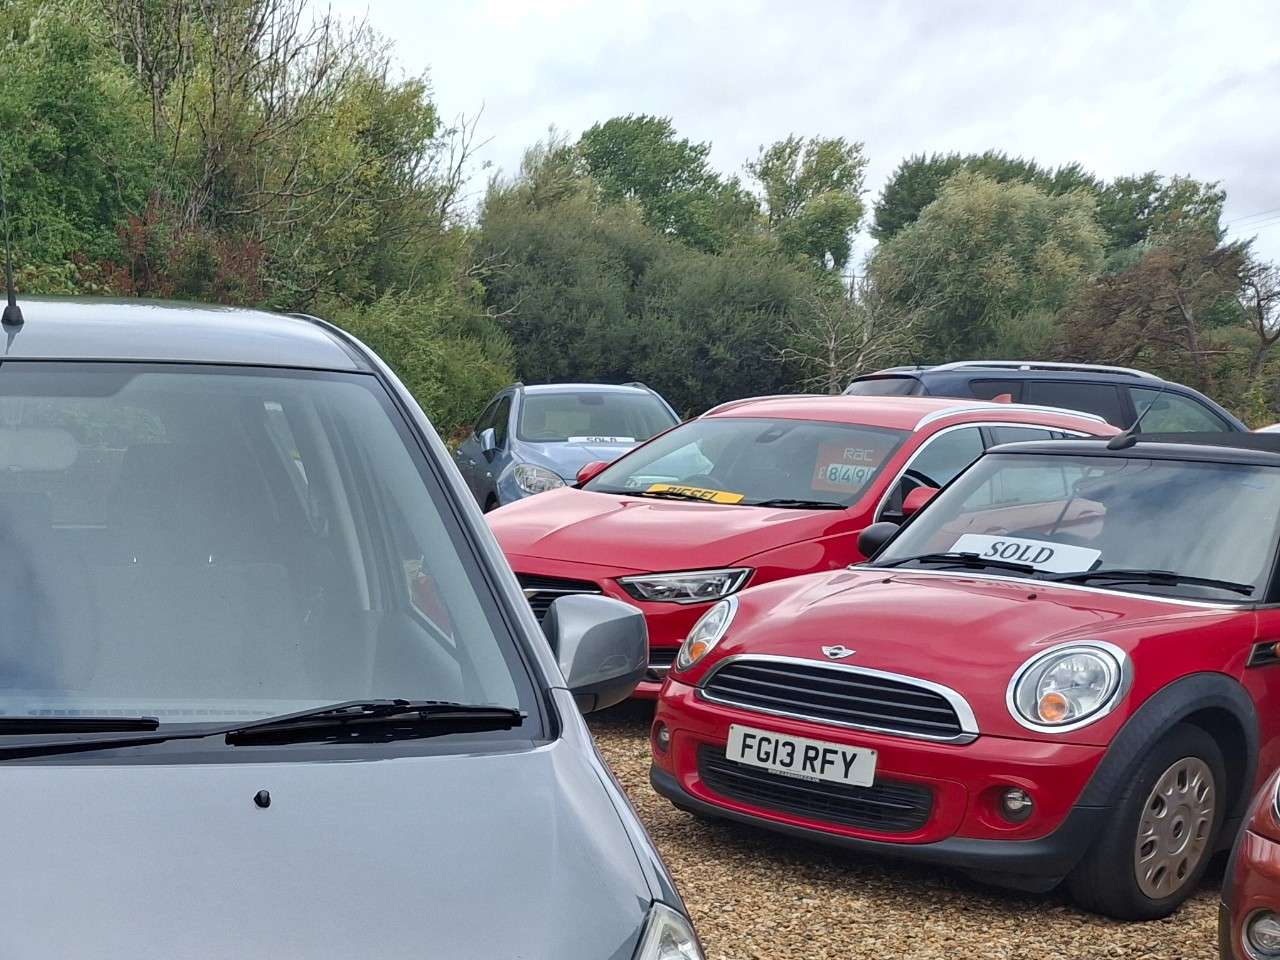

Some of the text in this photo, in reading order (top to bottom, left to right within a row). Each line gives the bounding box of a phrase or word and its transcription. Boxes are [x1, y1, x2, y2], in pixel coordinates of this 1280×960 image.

[984, 541, 1055, 564] SOLD
[740, 733, 859, 779] FG13 RFY
